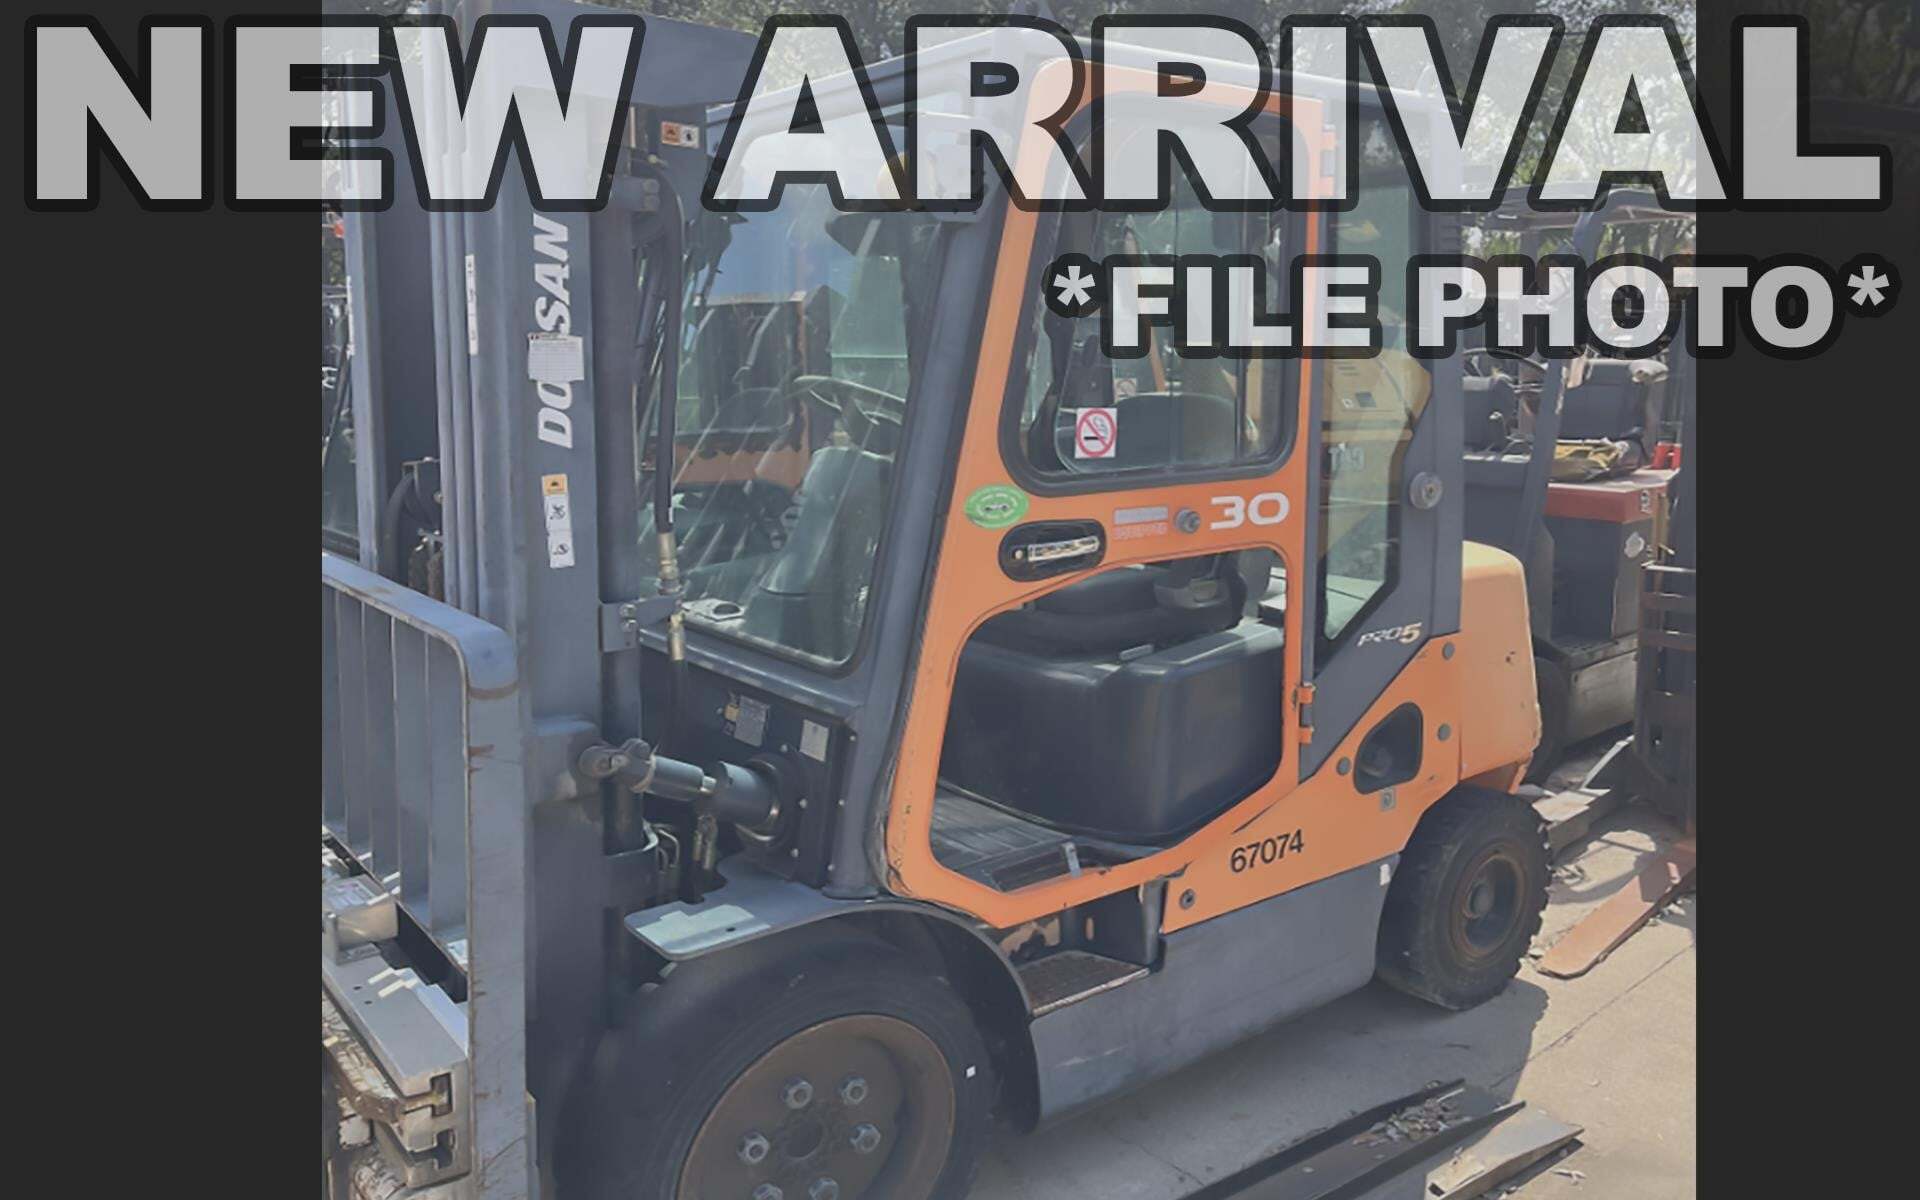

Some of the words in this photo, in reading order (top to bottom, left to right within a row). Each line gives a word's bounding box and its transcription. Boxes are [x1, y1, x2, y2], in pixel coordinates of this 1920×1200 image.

[533, 213, 573, 448] DOSAN
[1210, 493, 1290, 530] 30
[1230, 828, 1304, 873] 67074
